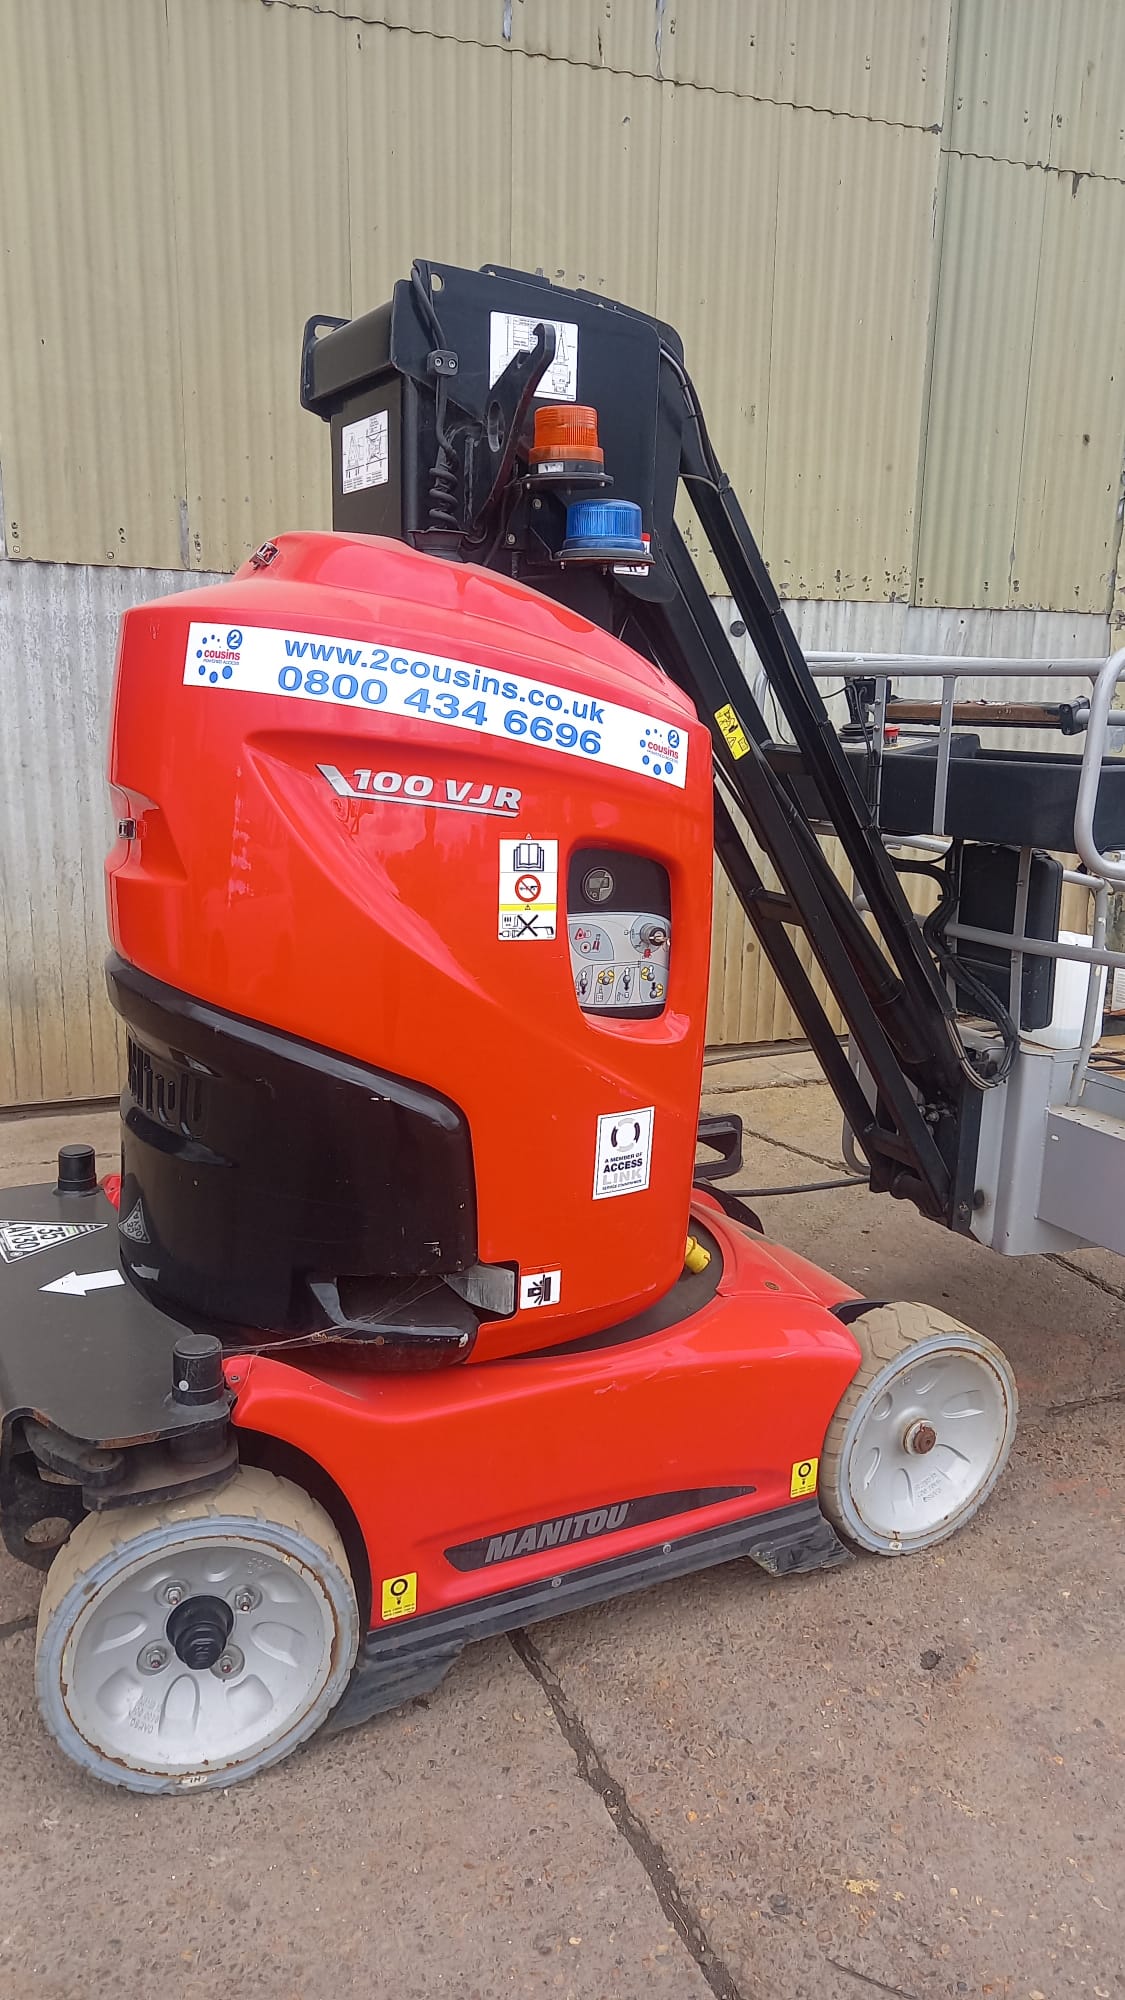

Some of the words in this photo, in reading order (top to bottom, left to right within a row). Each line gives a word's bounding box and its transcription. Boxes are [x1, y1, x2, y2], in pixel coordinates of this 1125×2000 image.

[204, 649, 240, 660] cousins
[285, 640, 606, 724] www.2cousins.co.uk
[278, 666, 388, 704] 0800
[404, 688, 487, 726] 434
[504, 710, 602, 755] 6696
[648, 741, 678, 759] cousins
[353, 769, 434, 797] 100
[446, 779, 522, 810] VJR
[603, 1158, 643, 1173] ACCESS
[610, 1154, 634, 1162] MEMBER
[603, 1169, 641, 1185] LINK
[37, 1227, 66, 1240] 35
[485, 1503, 629, 1563] MANITOU
